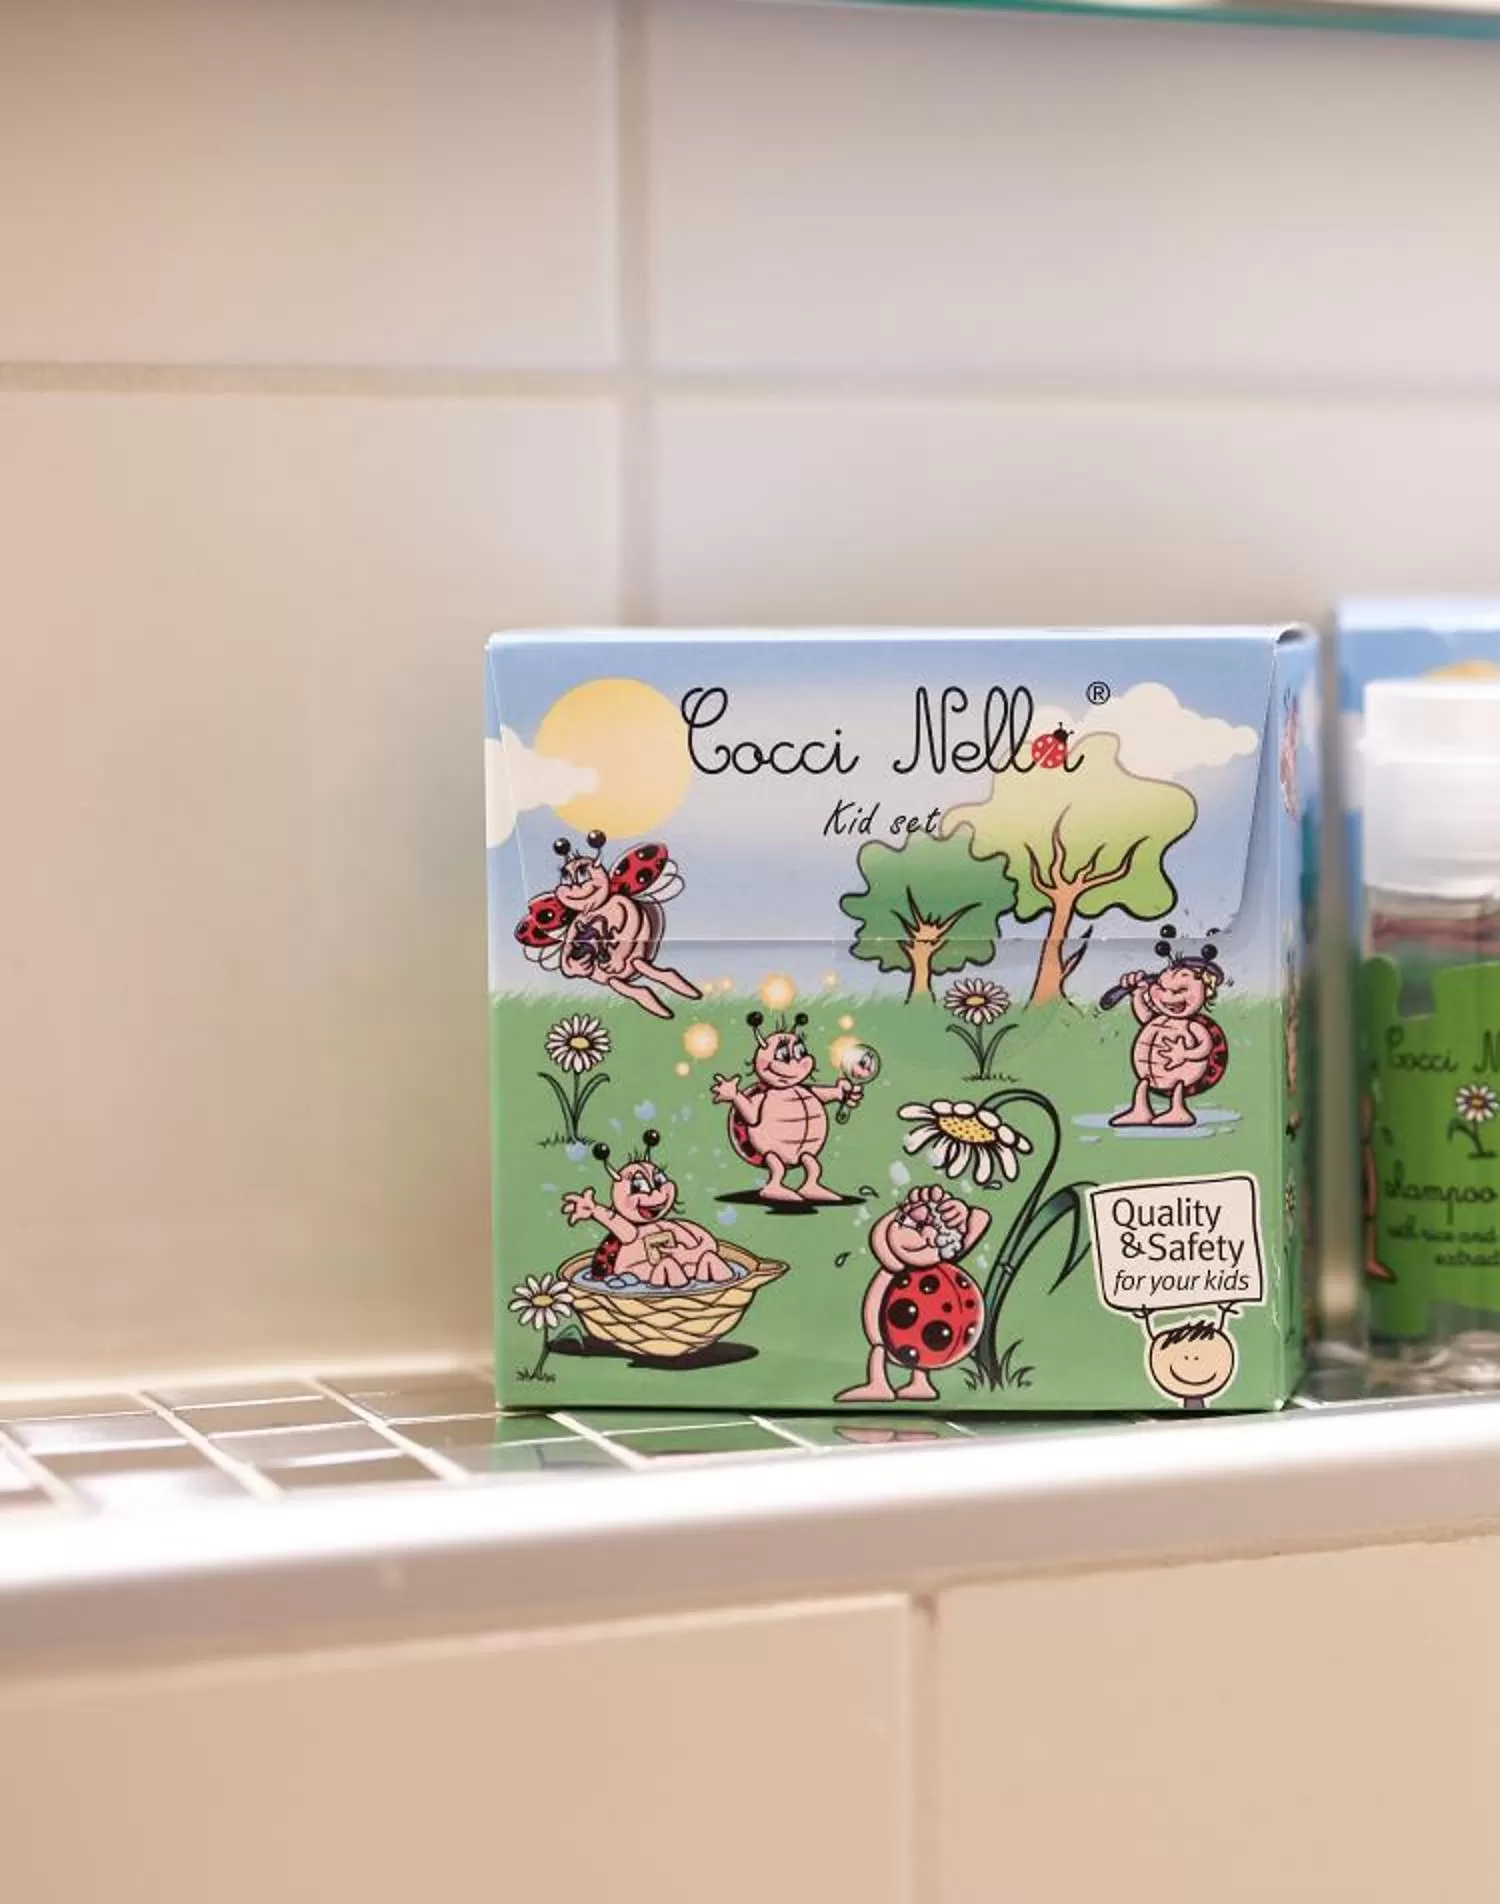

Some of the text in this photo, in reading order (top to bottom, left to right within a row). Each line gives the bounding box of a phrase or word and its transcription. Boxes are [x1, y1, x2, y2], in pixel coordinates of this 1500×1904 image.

[680, 686, 859, 777] Cocci
[823, 799, 939, 837] Kid set
[1111, 1197, 1222, 1233] Quality
[1113, 1269, 1250, 1296] for your kids
